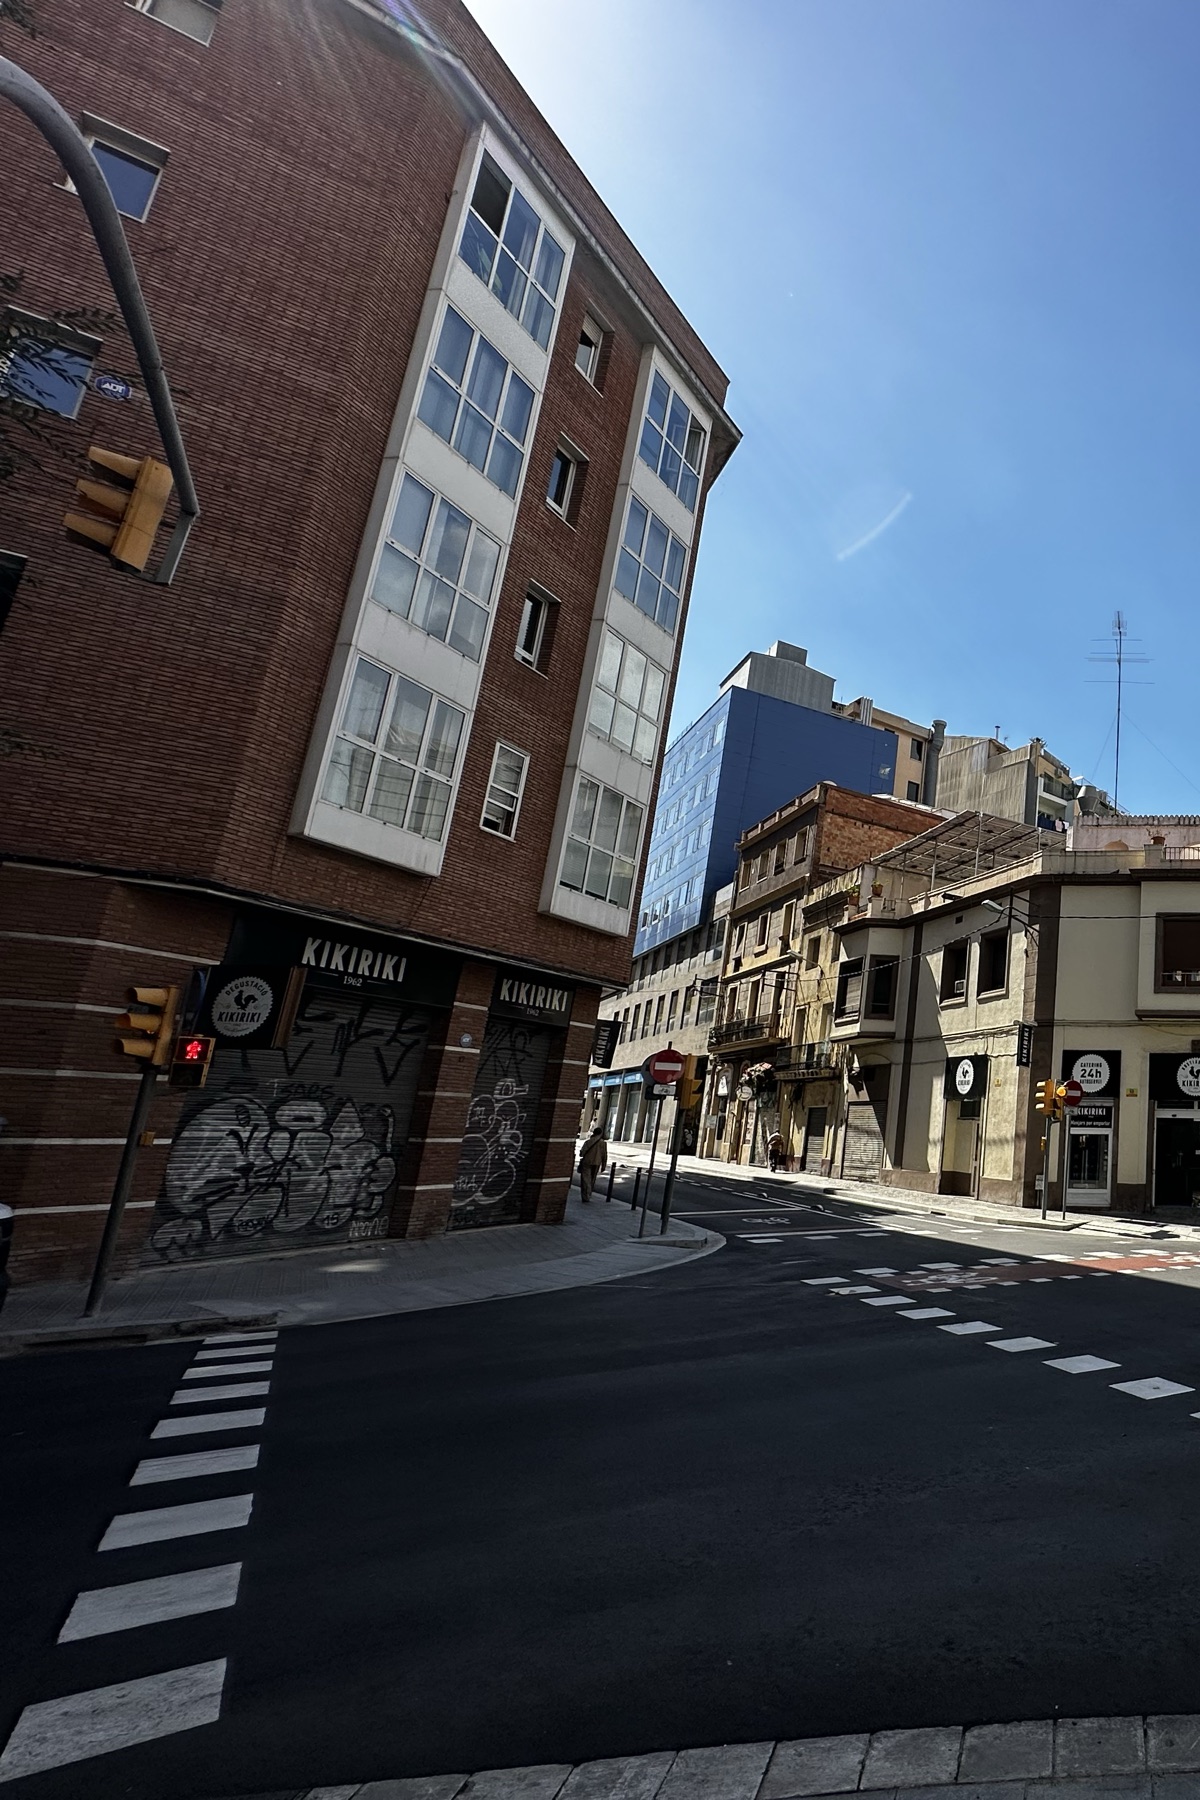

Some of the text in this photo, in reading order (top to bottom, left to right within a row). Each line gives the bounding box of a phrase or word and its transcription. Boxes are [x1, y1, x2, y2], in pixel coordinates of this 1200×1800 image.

[101, 382, 125, 393] ADT
[301, 937, 407, 982] KIKIRIKI
[343, 976, 363, 987] 1962
[500, 980, 568, 1012] KIKIRIKI
[218, 1011, 261, 1023] KIKIRIKI
[594, 1026, 611, 1064] KIKIRIKI
[1021, 1028, 1029, 1063] KIKIRIKI
[1080, 1068, 1102, 1079] 24h
